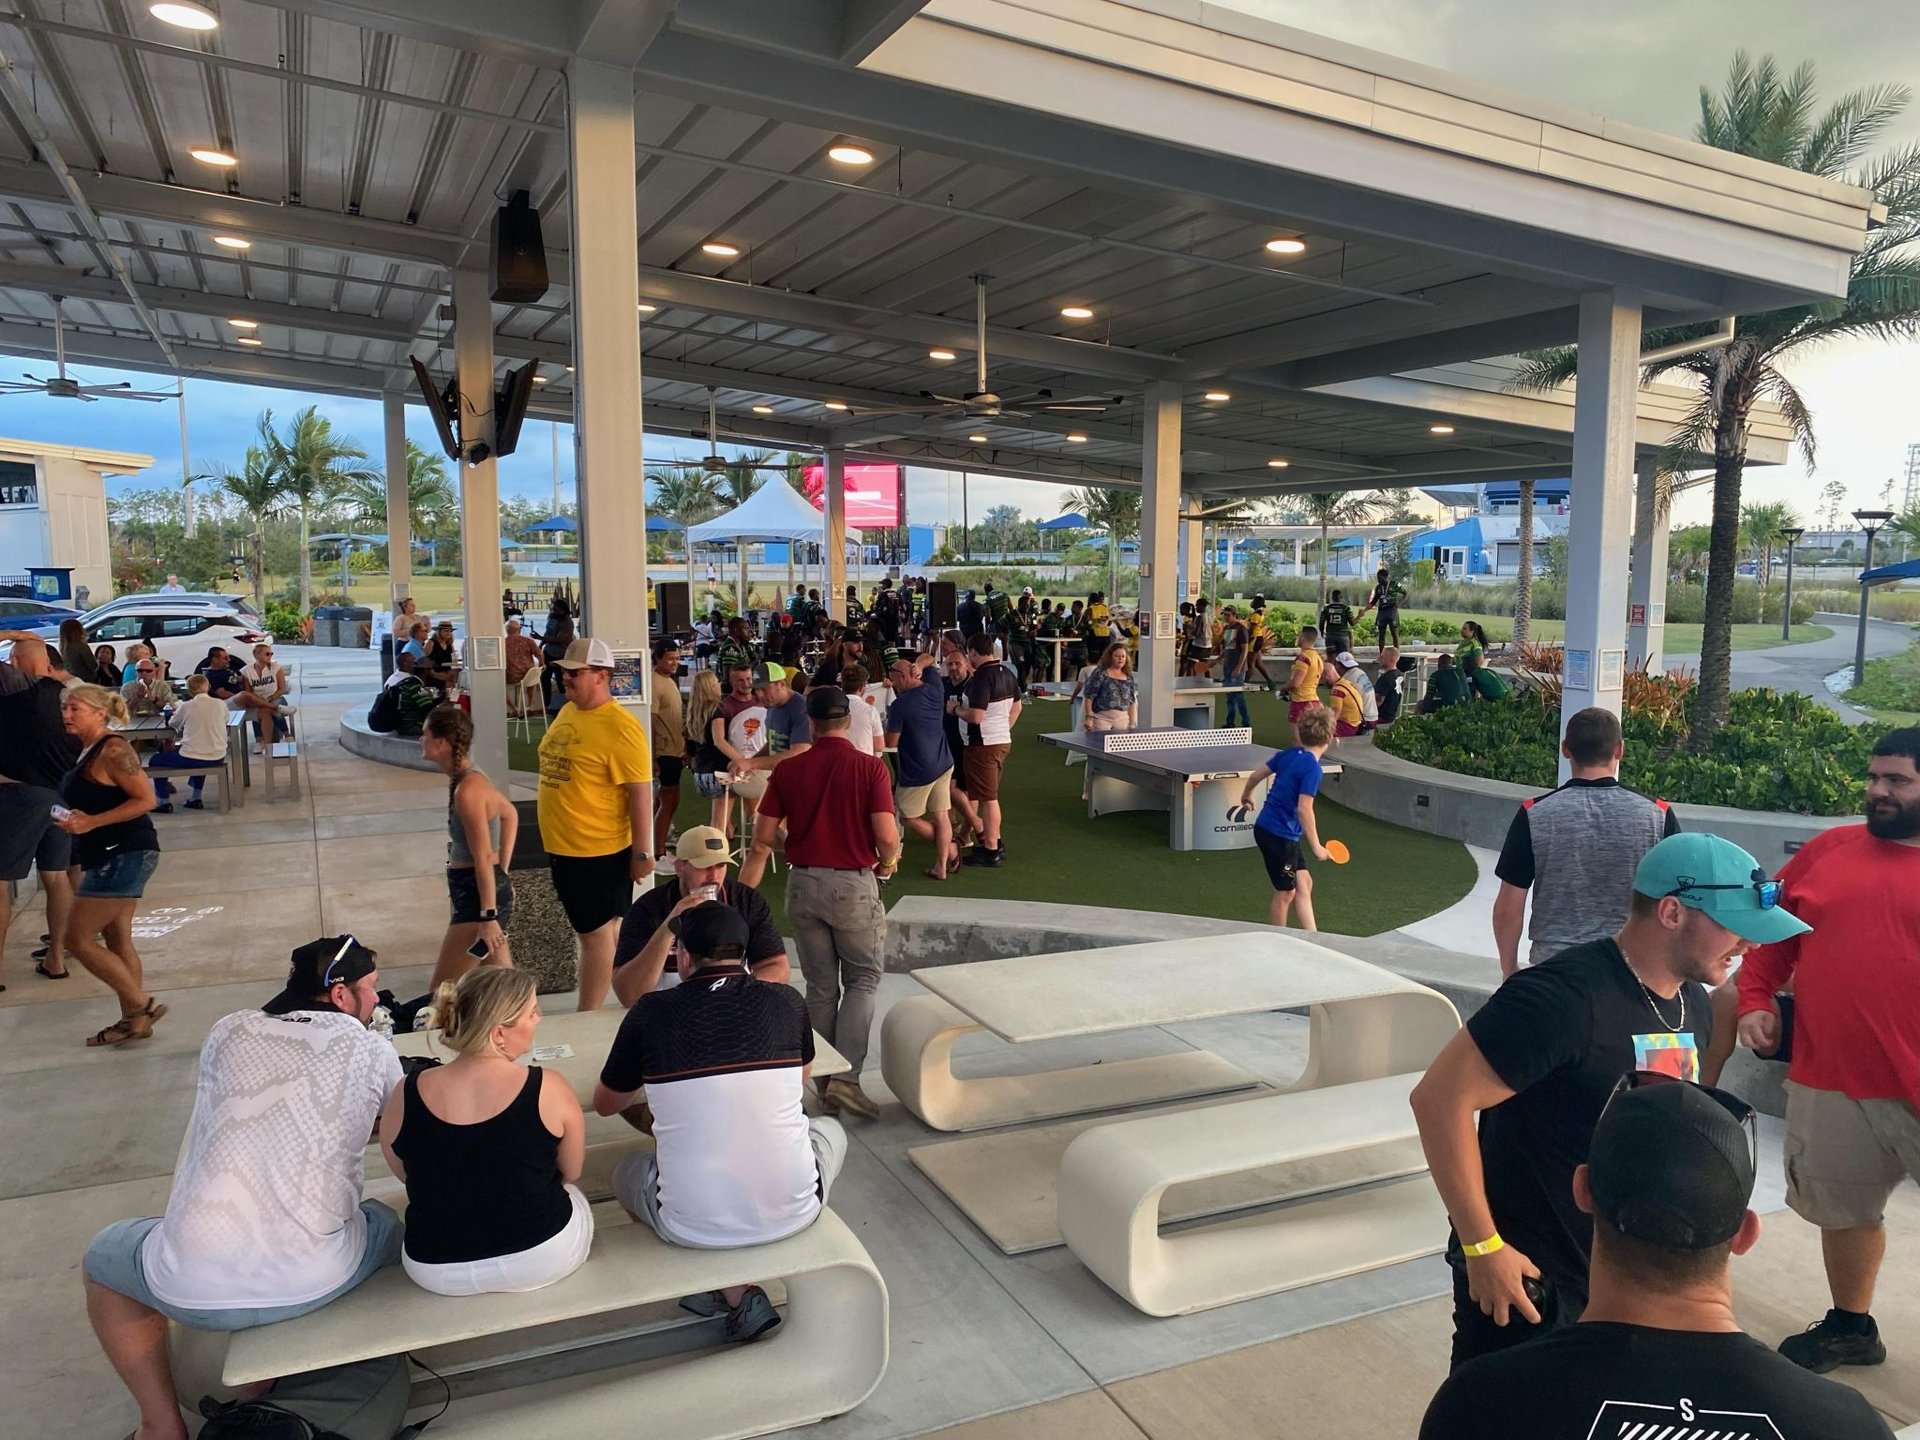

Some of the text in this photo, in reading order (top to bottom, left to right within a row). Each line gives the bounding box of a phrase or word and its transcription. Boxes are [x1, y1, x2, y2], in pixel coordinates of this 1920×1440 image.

[1328, 614, 1342, 624] 12
[251, 675, 276, 687] JAMAICA
[1679, 1397, 1695, 1422] S
